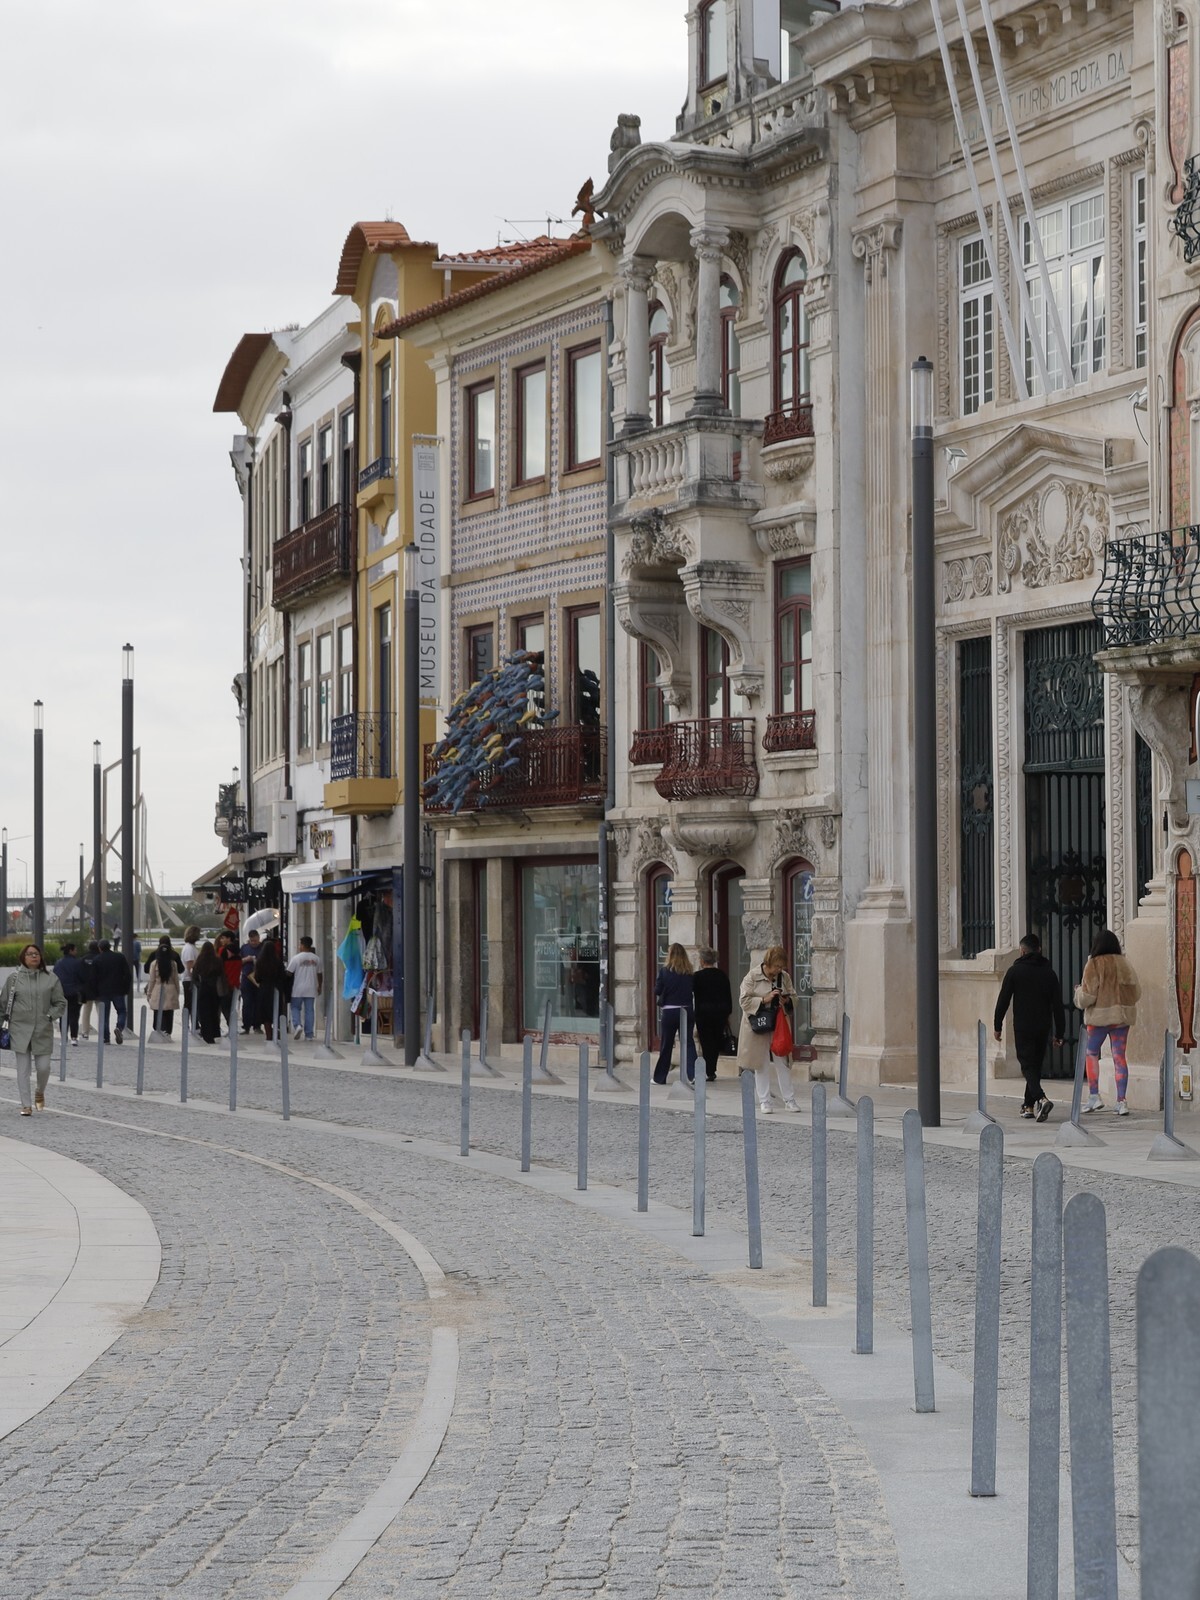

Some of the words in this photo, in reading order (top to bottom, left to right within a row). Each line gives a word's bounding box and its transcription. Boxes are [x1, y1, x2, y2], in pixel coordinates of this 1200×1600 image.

[1017, 76, 1066, 118] TURISMO
[1070, 61, 1101, 98] ROTA
[1107, 50, 1125, 80] DA
[419, 490, 435, 565] CIDADE
[420, 578, 436, 603] DA
[420, 617, 436, 688] MUSEU
